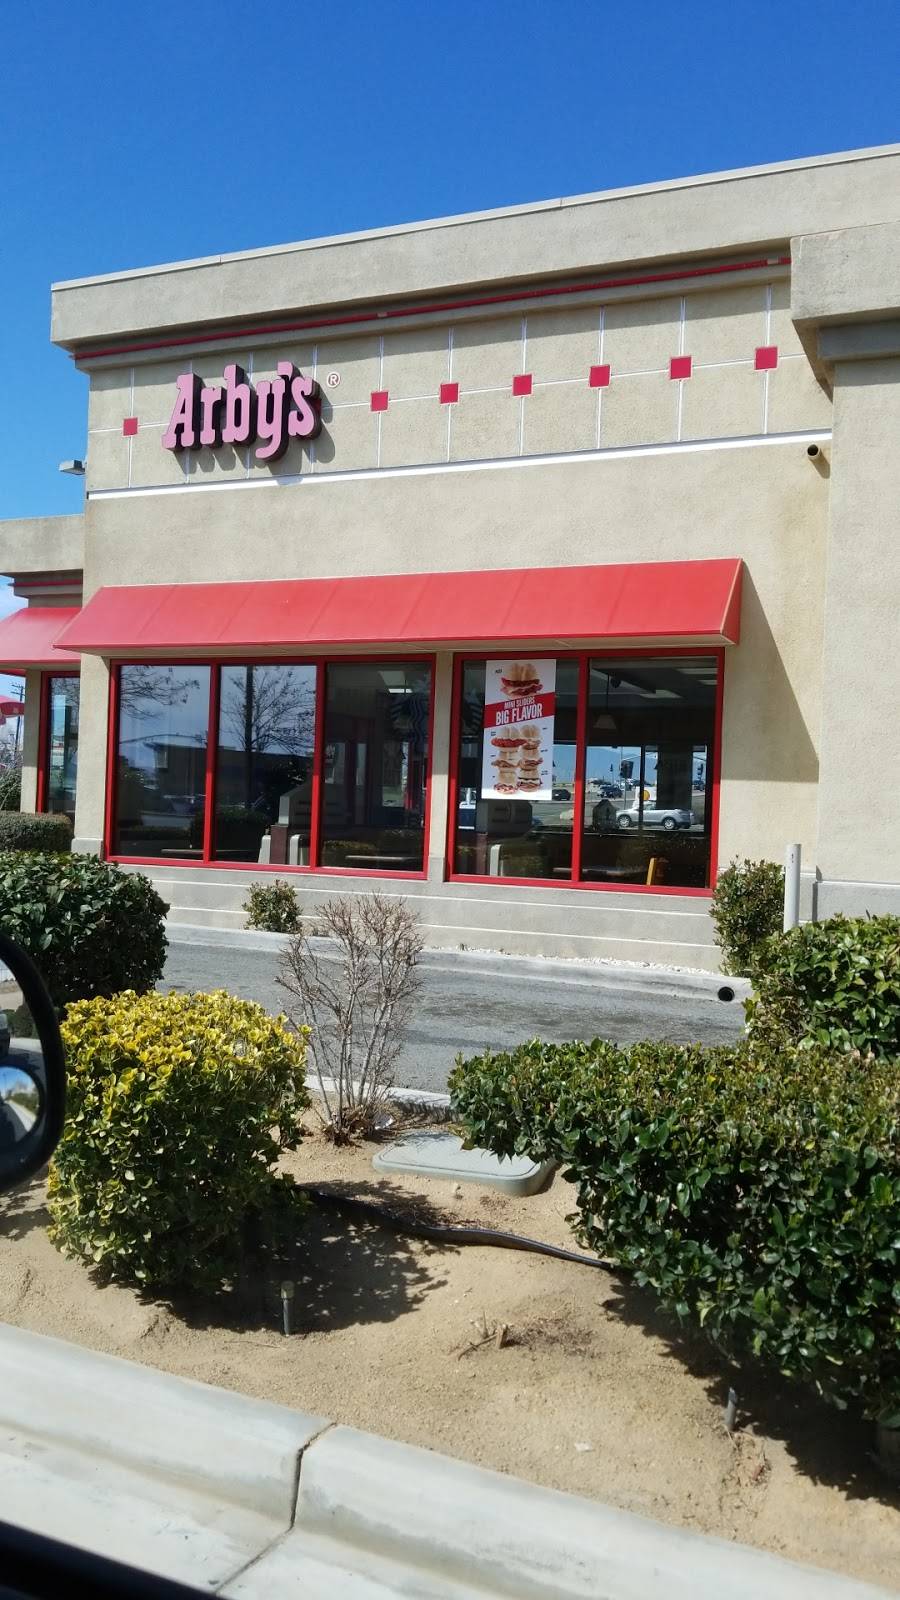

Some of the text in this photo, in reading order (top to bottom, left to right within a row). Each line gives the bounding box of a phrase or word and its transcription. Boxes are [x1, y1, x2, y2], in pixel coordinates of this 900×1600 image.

[162, 361, 320, 460] Arby's
[504, 696, 535, 709] MINI SLIDERS
[496, 703, 543, 725] BIG FLAVOR
